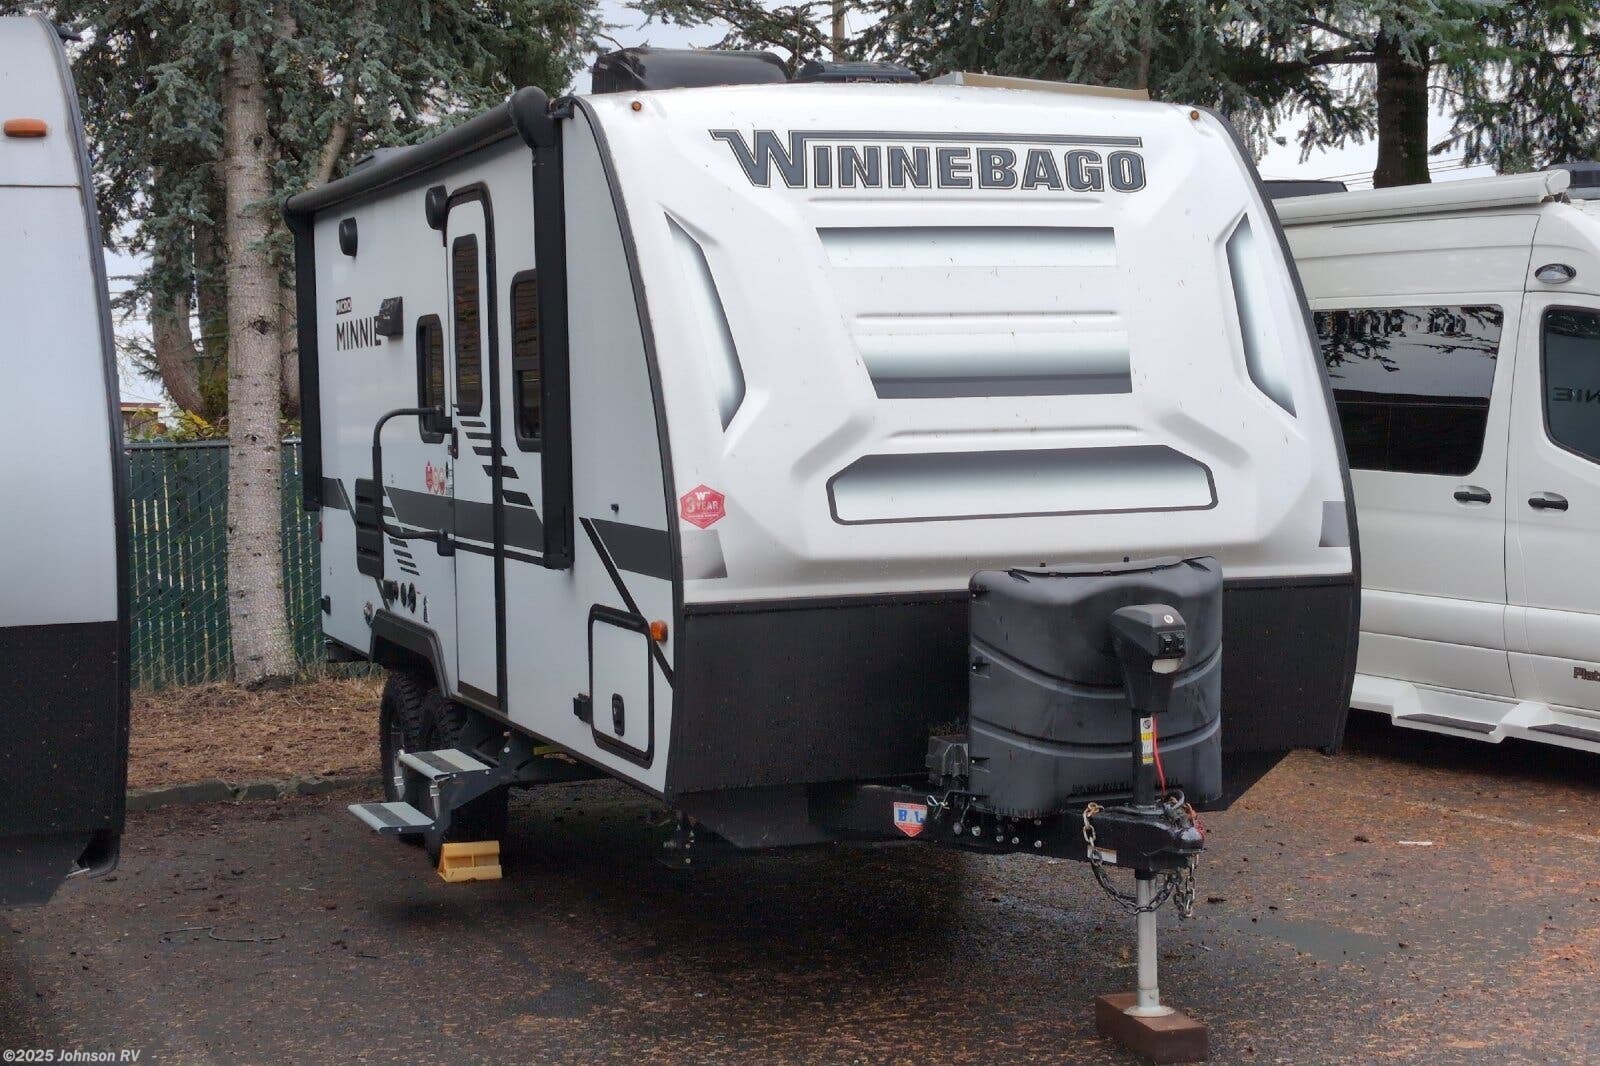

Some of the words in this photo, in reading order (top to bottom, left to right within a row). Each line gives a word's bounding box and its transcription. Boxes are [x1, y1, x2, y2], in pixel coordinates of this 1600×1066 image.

[709, 129, 1147, 193] WINNEBAGO
[686, 498, 696, 513] 3
[696, 501, 719, 511] YEAR
